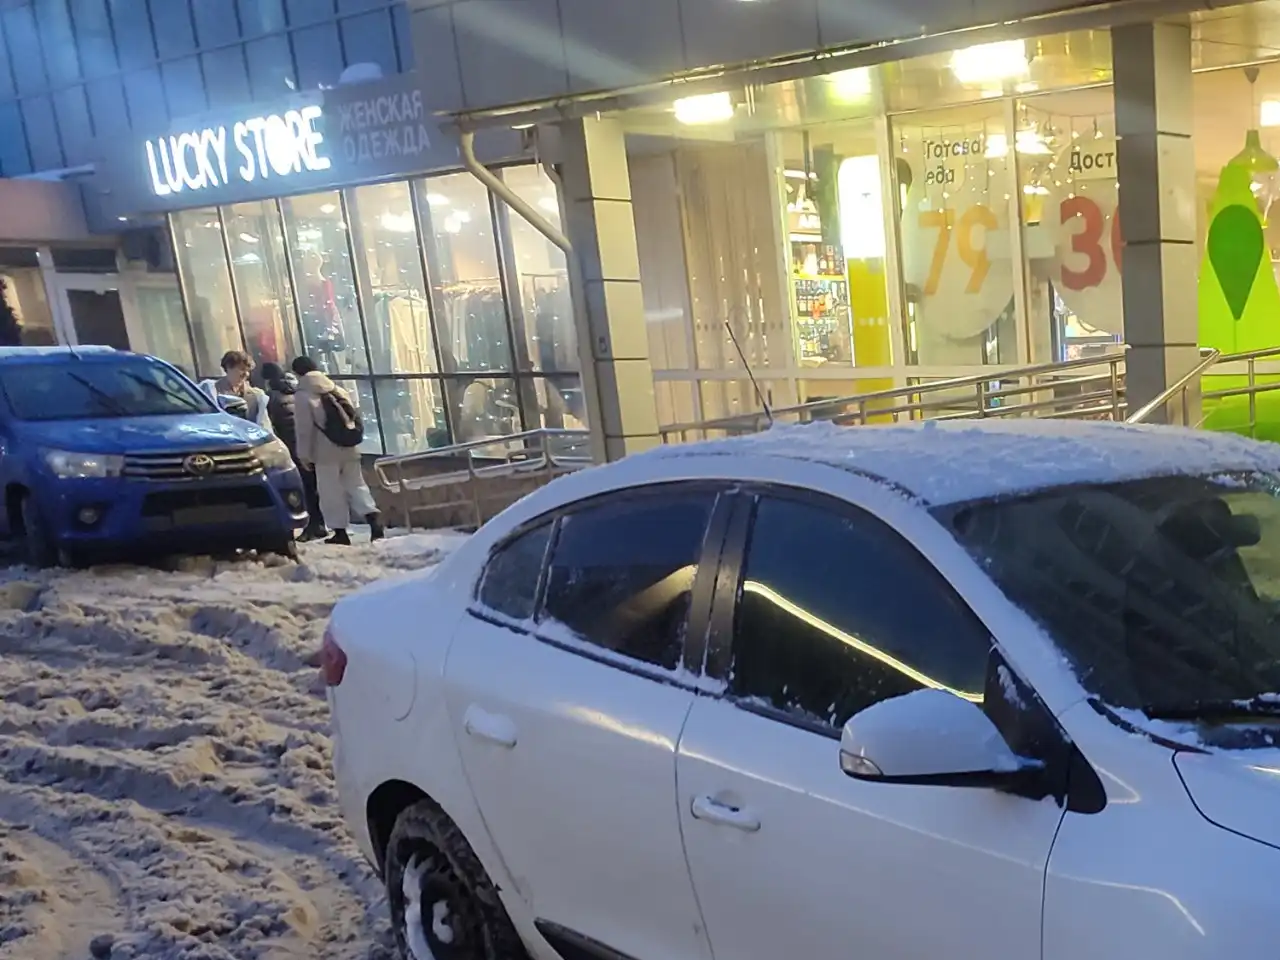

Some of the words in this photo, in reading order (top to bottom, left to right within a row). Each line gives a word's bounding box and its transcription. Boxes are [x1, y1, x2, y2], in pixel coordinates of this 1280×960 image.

[338, 90, 424, 133] ЖЕНСКАЯ
[145, 125, 229, 196] LUCKY
[233, 104, 331, 183] STORE
[343, 123, 431, 163] ОДЕЖДА
[926, 138, 983, 160] Готова
[1069, 151, 1117, 174] Дост
[926, 165, 955, 185] еда
[917, 204, 998, 296] 79
[1060, 195, 1123, 291] 3
